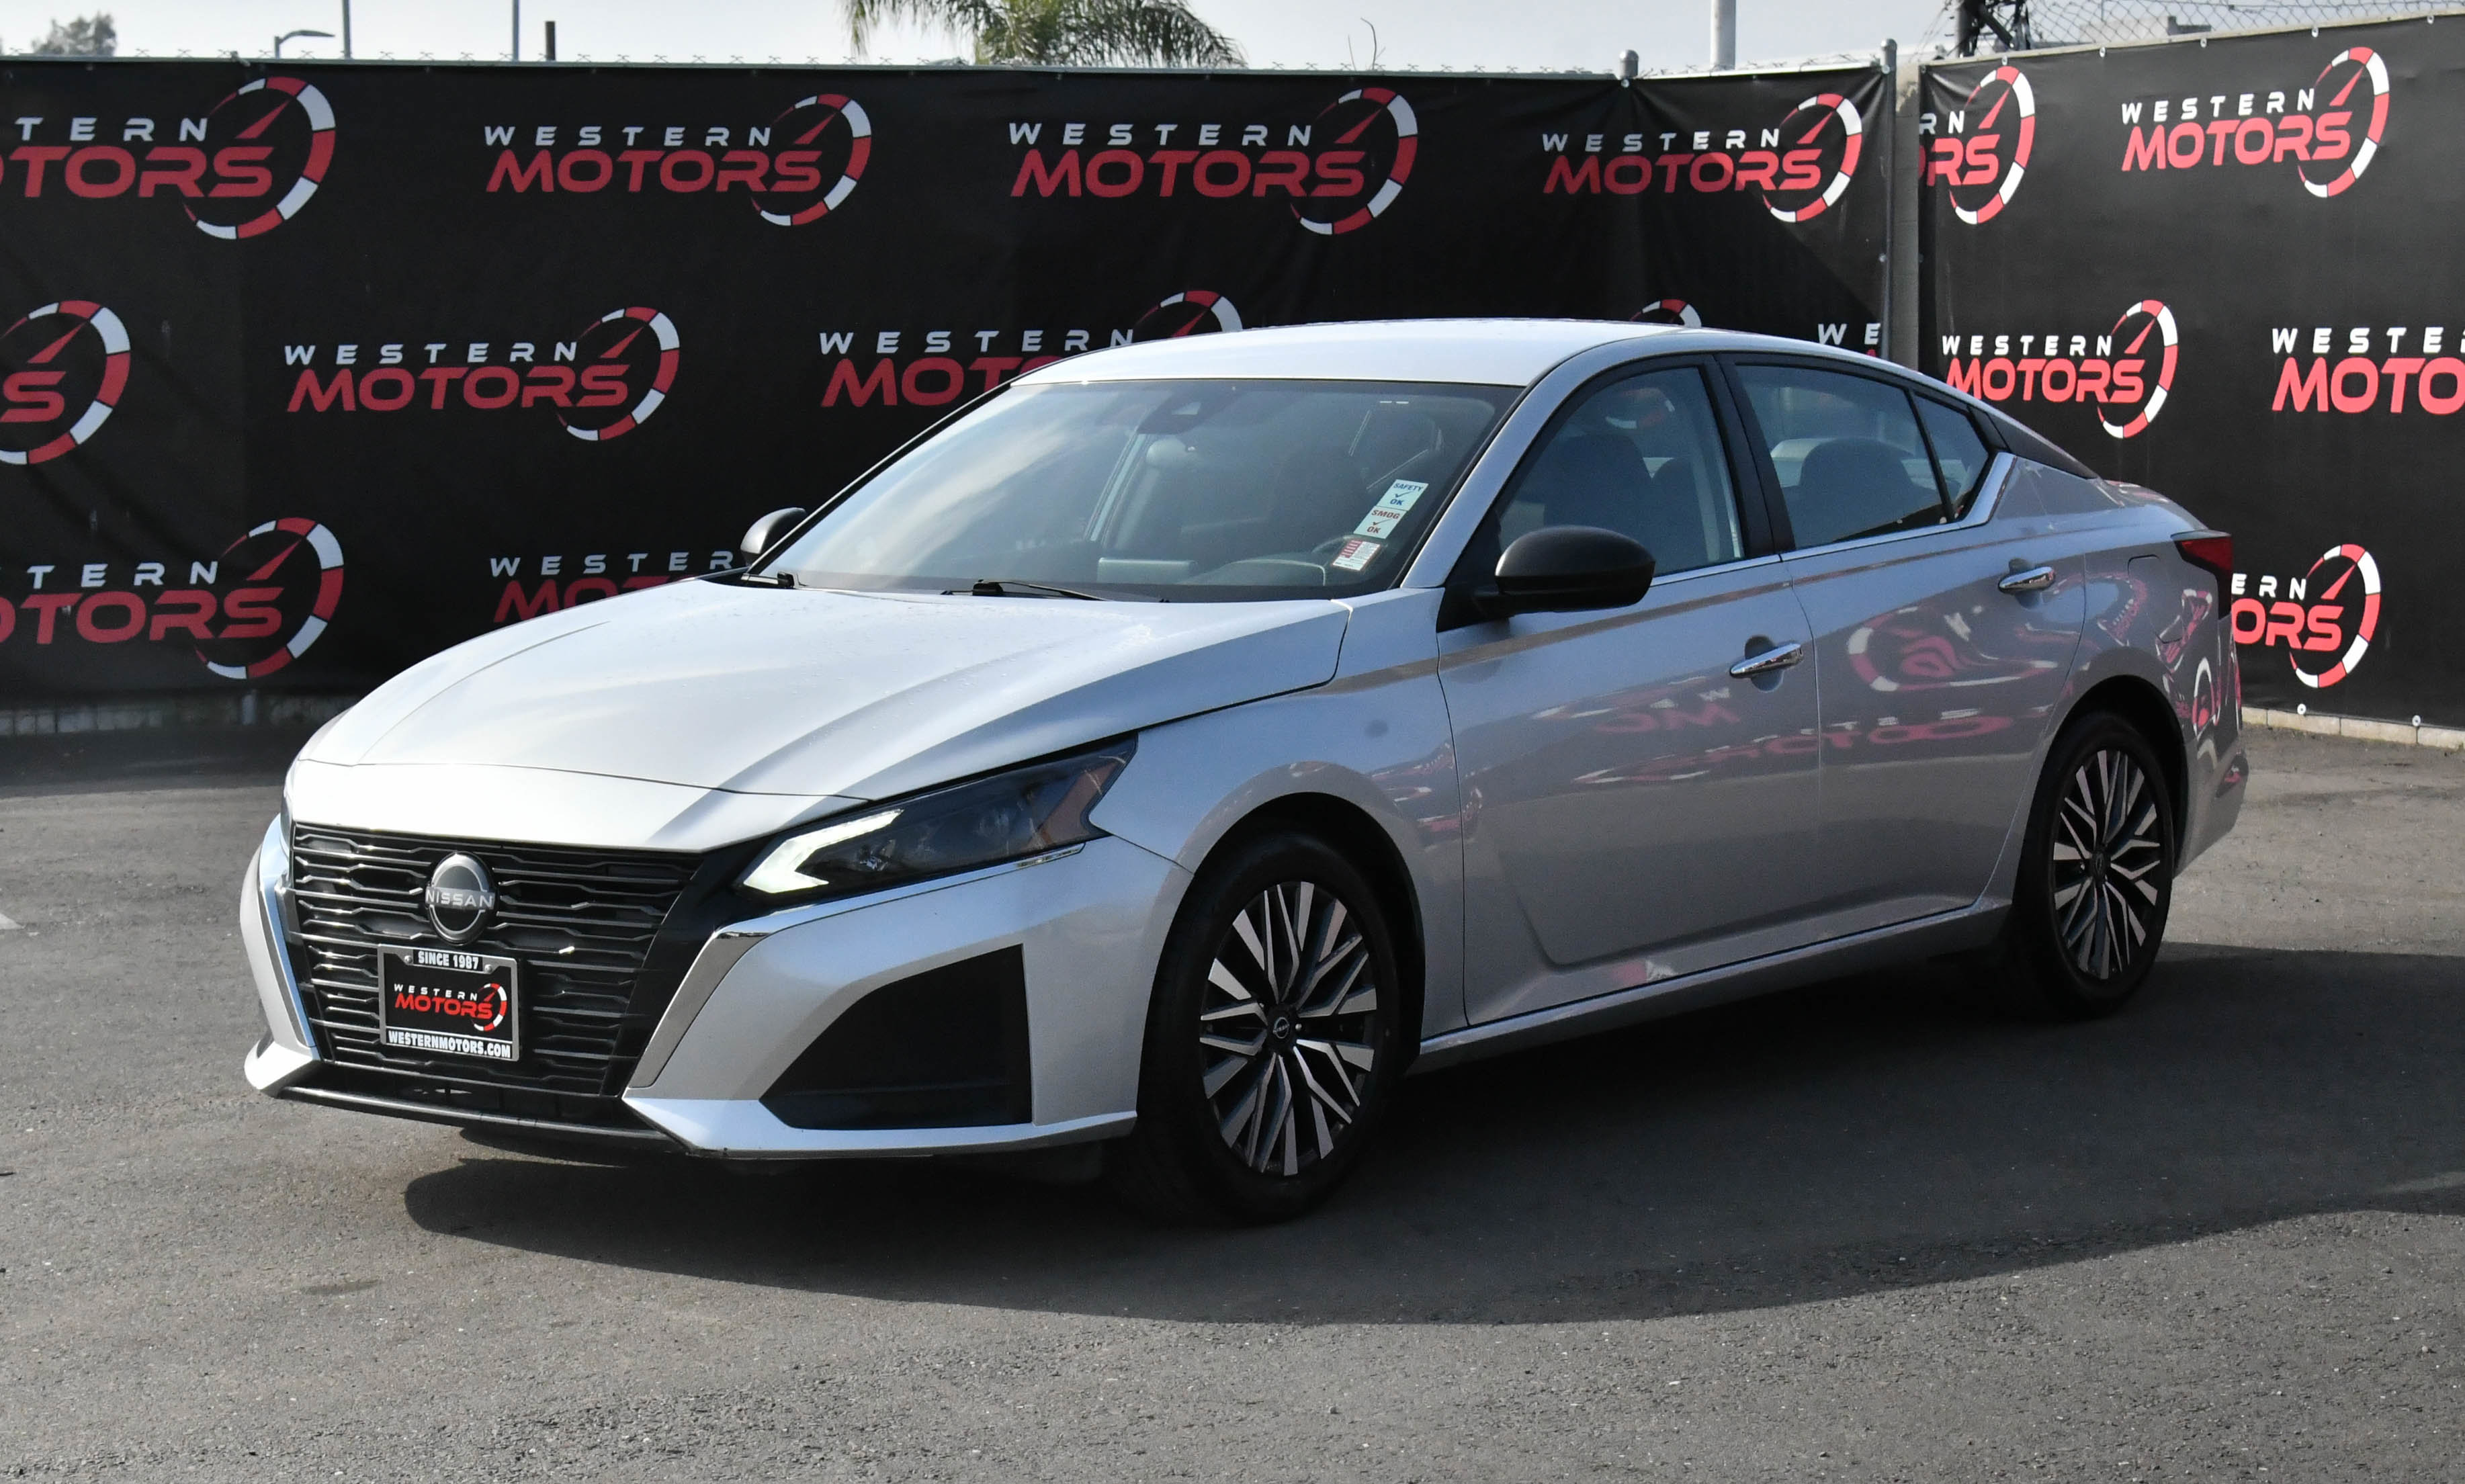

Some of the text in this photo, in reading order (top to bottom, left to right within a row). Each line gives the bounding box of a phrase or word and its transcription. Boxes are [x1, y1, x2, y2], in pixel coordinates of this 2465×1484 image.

[2121, 87, 2315, 126] WESTERN
[15, 117, 207, 141] TERN
[484, 126, 771, 146] WESTERN
[1009, 122, 1311, 146] WESTERN
[1543, 128, 1780, 152] WESTERN
[2121, 110, 2354, 173] MOTORS
[0, 145, 274, 198] TORS
[486, 148, 823, 193] MOTORS
[1011, 148, 1366, 198] MOTORS
[1545, 149, 1823, 194] MOTORS
[1919, 134, 2000, 187] RS
[285, 342, 577, 365] WESTERN
[820, 329, 1135, 354] WESTERN
[1942, 335, 2113, 357] WESTERN
[2272, 326, 2465, 355] WESTE
[287, 365, 631, 412] MOTORS
[821, 356, 1064, 408] MOT
[1946, 357, 2146, 403] MOTORS
[1393, 482, 1424, 492] SAFETY
[1371, 510, 1401, 520] SMOG
[26, 561, 218, 589] TERN
[0, 587, 284, 644] TORS
[425, 888, 493, 908] NISSAN
[418, 951, 478, 969] SINCE 1987
[394, 983, 478, 1002] WESTERN
[394, 992, 493, 1020] MOTORS
[388, 1030, 511, 1058] WESTERNMOTORS.COM
